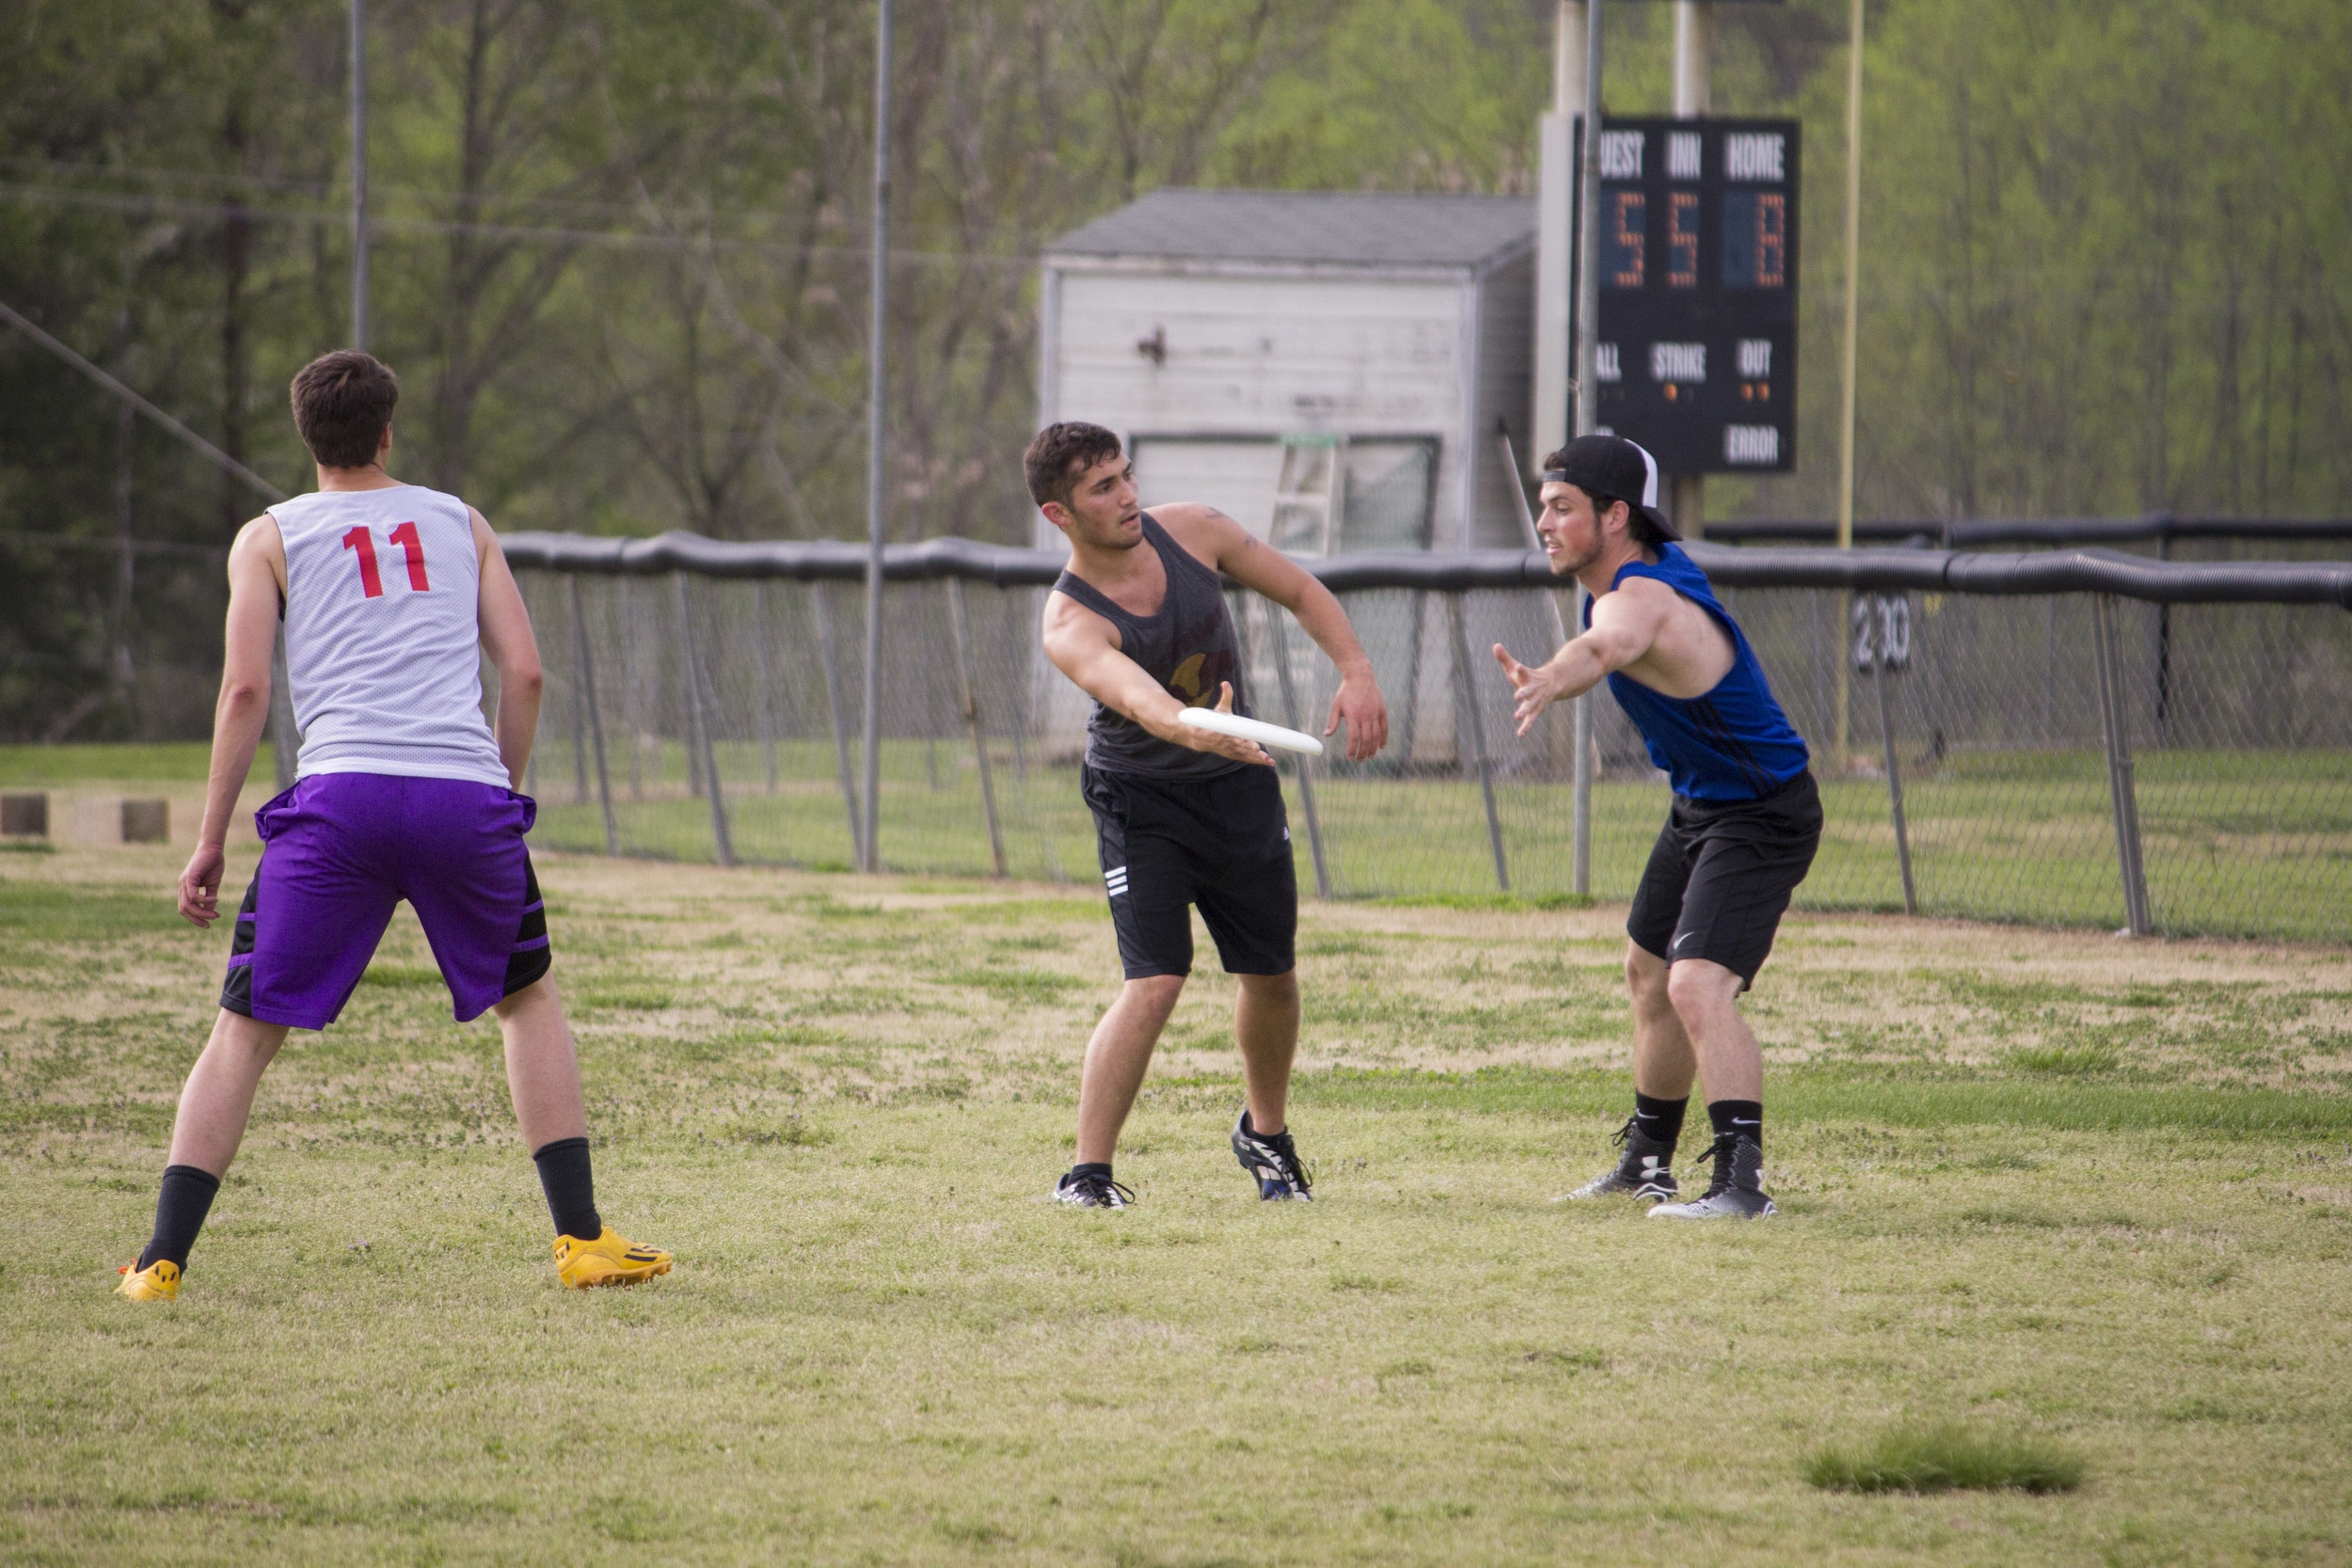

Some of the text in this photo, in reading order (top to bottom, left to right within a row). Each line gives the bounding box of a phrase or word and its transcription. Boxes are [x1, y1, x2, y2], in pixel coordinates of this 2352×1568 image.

[1600, 131, 1645, 179] UEST
[1667, 132, 1701, 179] INN
[1726, 133, 1785, 180] HOME
[1614, 193, 1645, 286] 5
[1667, 193, 1698, 287] 5
[1756, 194, 1784, 287] 8
[1597, 342, 1621, 381] ALL
[1653, 341, 1707, 382] STRIKE
[1740, 340, 1772, 377] OUT
[1727, 424, 1778, 465] ERROR
[342, 520, 430, 599] 11
